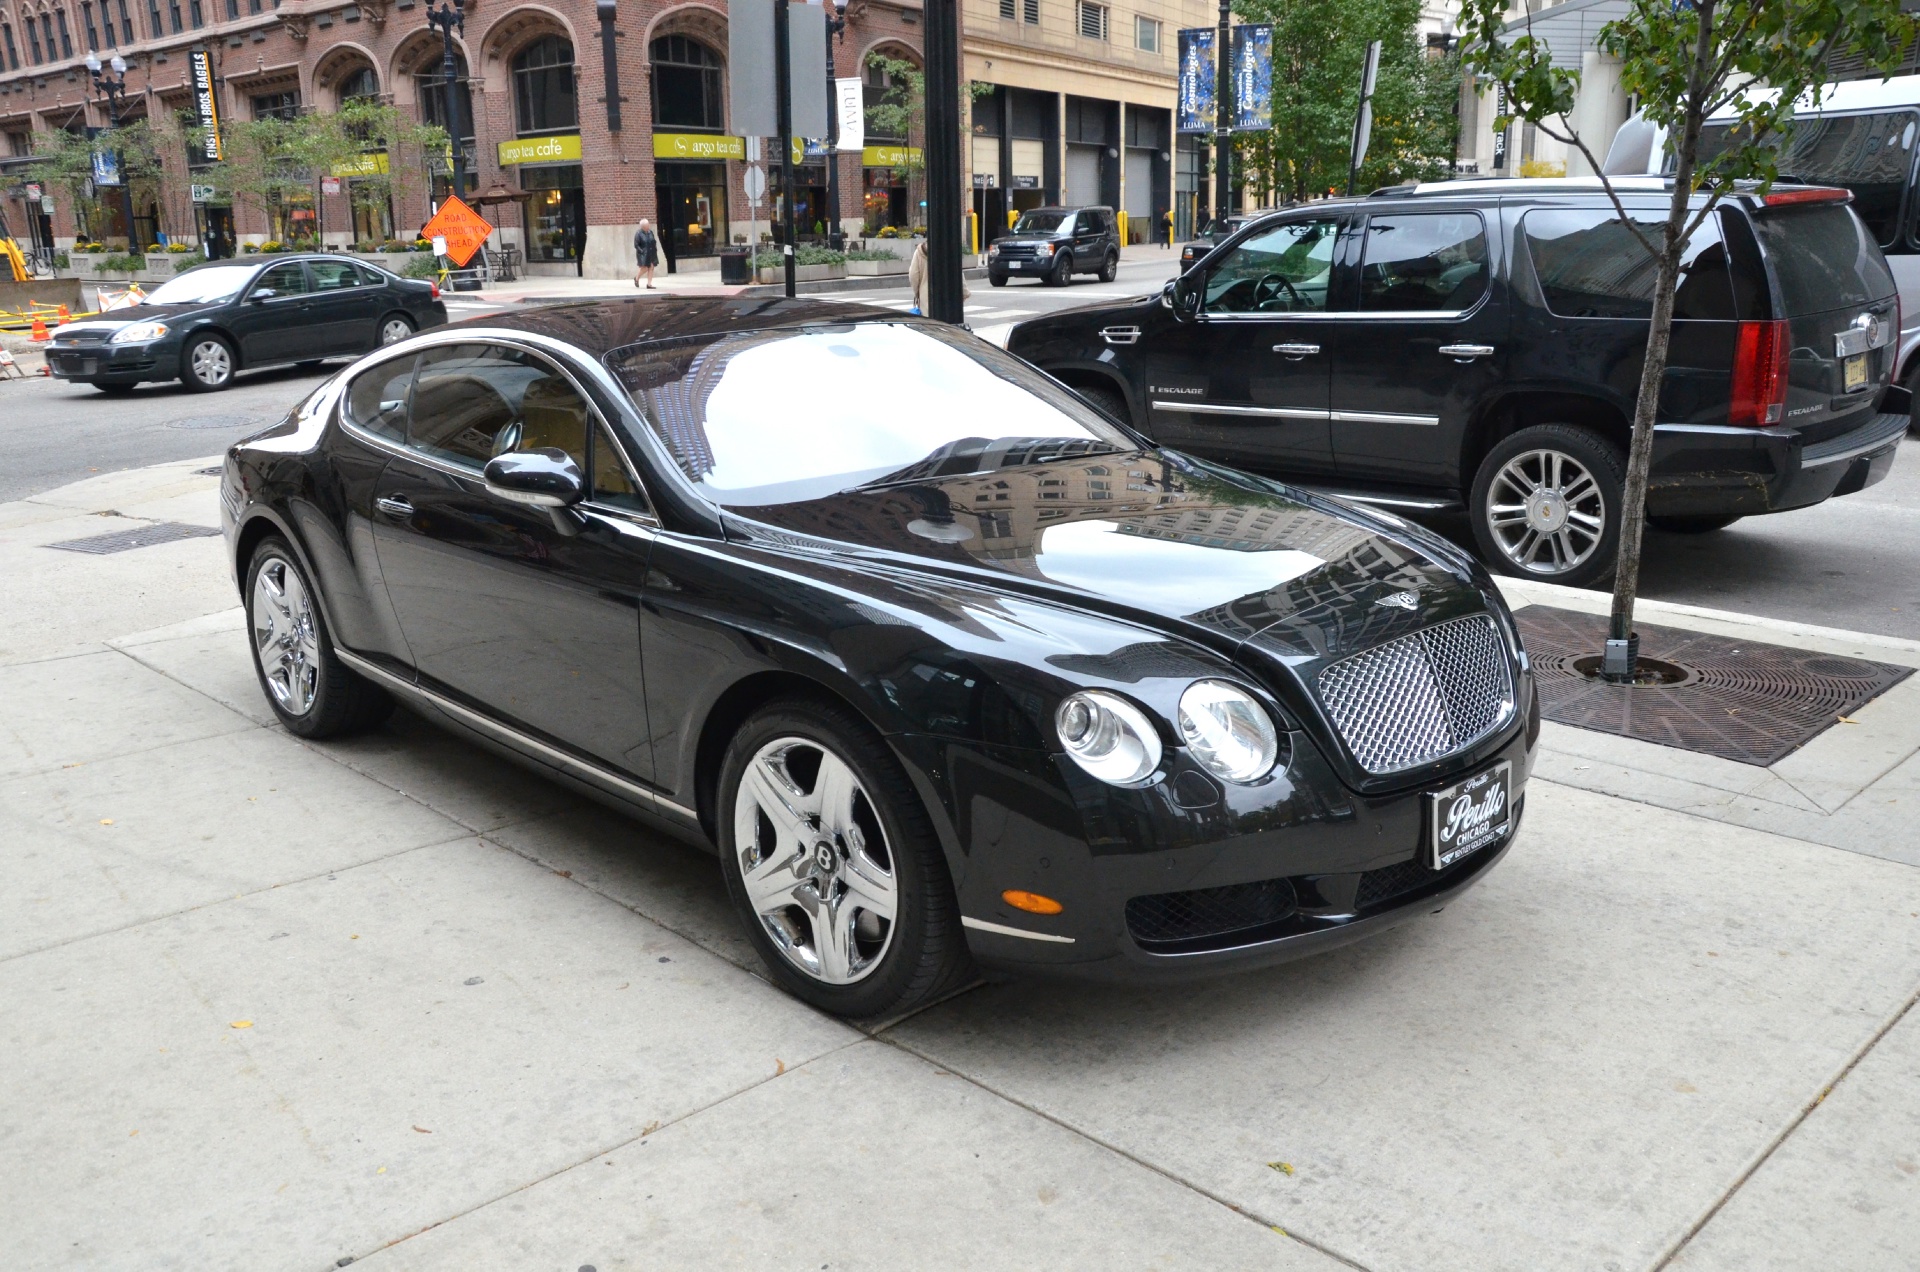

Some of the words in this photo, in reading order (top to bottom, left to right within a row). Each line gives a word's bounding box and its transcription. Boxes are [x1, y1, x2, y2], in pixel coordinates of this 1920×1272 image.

[193, 53, 209, 89] BAGELS
[1186, 45, 1198, 113] Cosmologies
[1243, 41, 1255, 110] Cosmologies
[199, 91, 212, 116] BROS.
[1240, 119, 1263, 127] LUMA
[202, 118, 218, 159] EINSTIN
[522, 146, 534, 157] tea
[536, 139, 562, 156] café
[692, 142, 714, 156] argo
[716, 141, 728, 153] tea
[1495, 132, 1505, 155] rack
[444, 213, 467, 222] ROAD
[427, 226, 486, 237] CONSTRUCTION
[446, 238, 473, 248] AHEAD
[1158, 386, 1203, 394] ESCALADE
[1786, 404, 1824, 416] ESCALADE
[1464, 773, 1489, 793] Perillo
[1441, 782, 1505, 842] Perillo
[1456, 821, 1490, 846] CHICAGO
[1454, 845, 1471, 858] BENTLEY
[1471, 837, 1482, 850] GOLD
[1482, 831, 1495, 844] COAST
